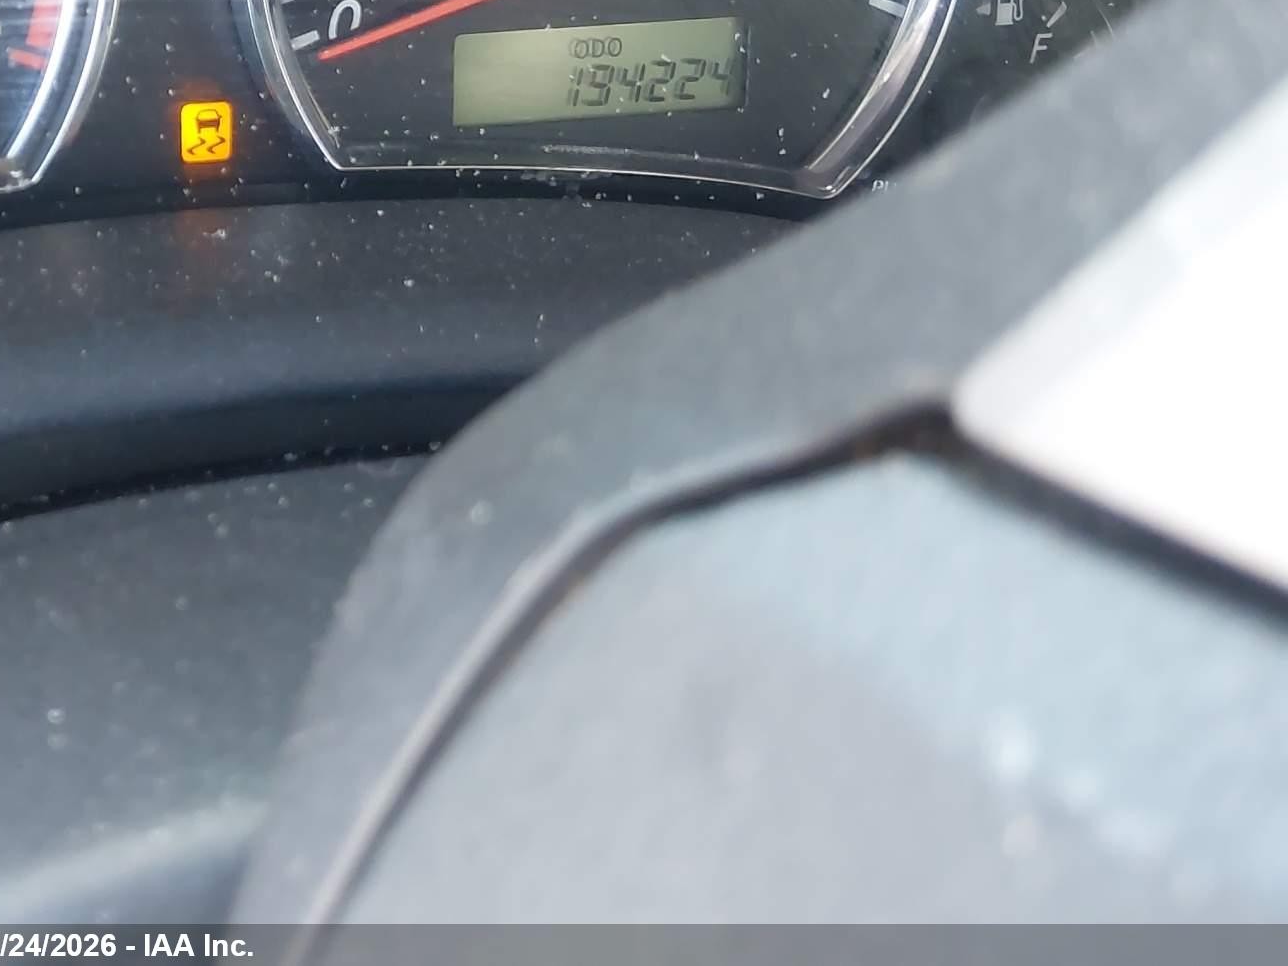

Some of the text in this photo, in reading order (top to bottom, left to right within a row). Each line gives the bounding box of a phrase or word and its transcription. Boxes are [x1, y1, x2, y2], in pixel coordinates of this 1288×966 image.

[328, 0, 362, 40] 0
[574, 37, 622, 59] ODO
[1030, 33, 1053, 63] F
[567, 58, 736, 107] 194224
